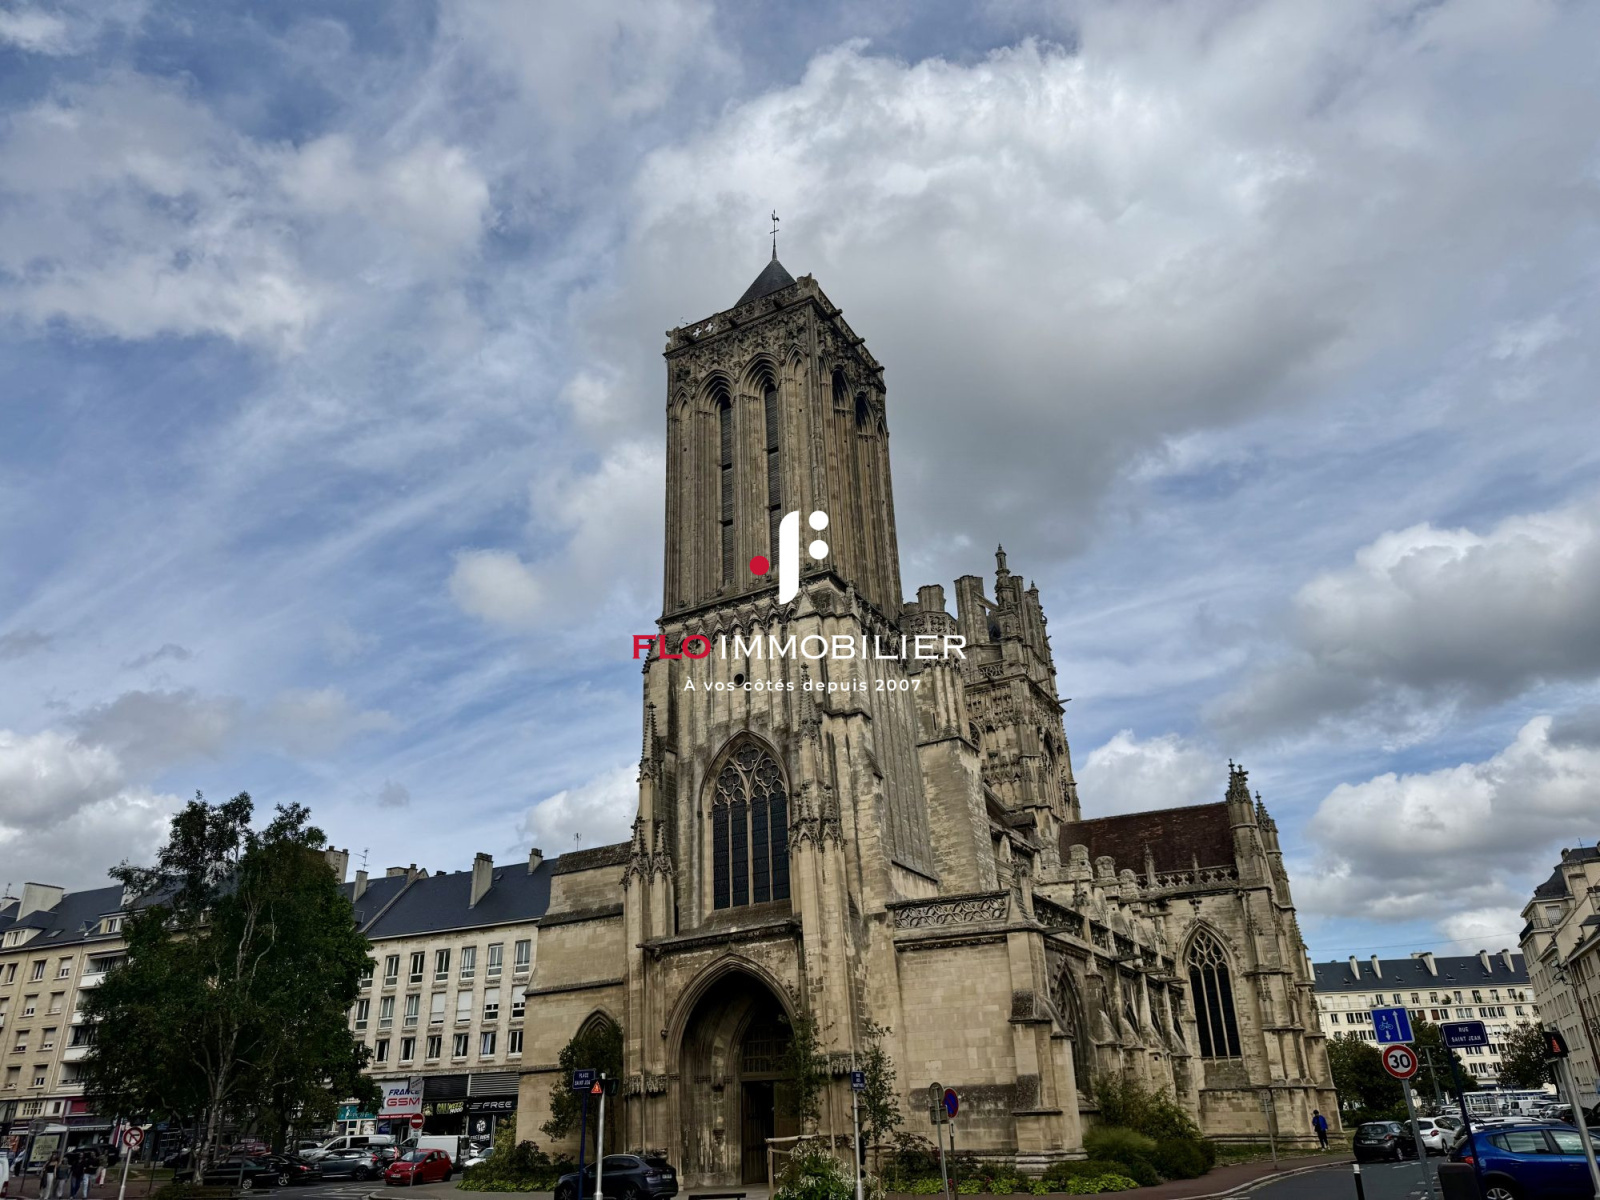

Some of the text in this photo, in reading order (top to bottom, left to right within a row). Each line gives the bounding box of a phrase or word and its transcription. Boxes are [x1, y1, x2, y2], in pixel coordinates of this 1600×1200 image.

[1389, 1053, 1411, 1069] 30
[387, 1097, 420, 1107] GSM
[482, 1101, 512, 1109] FREE
